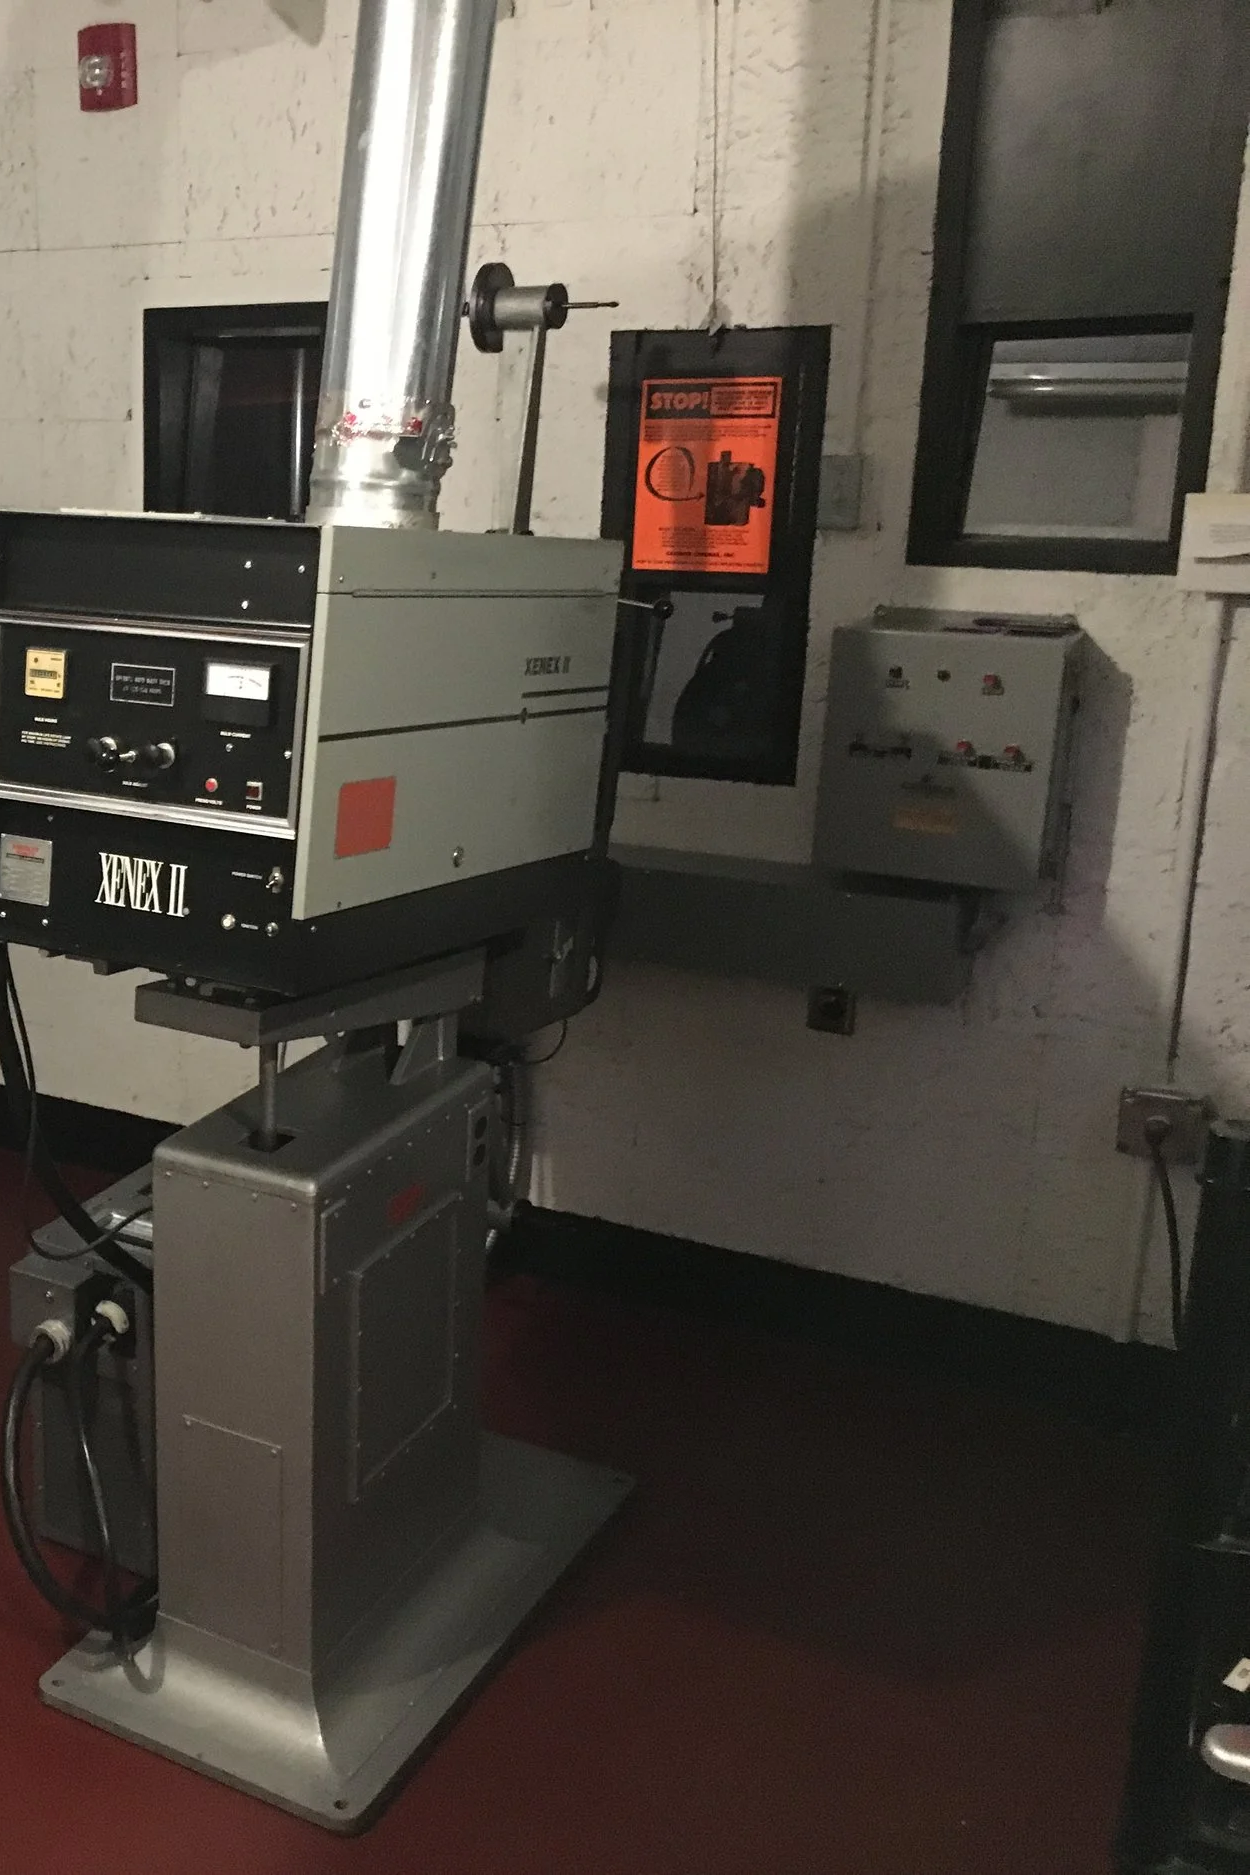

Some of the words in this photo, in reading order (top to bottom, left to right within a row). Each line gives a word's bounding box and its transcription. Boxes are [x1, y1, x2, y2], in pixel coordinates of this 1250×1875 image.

[649, 391, 709, 411] STOP!
[524, 658, 560, 676] XENEX
[94, 852, 164, 914] XENEX
[166, 863, 189, 918] II
